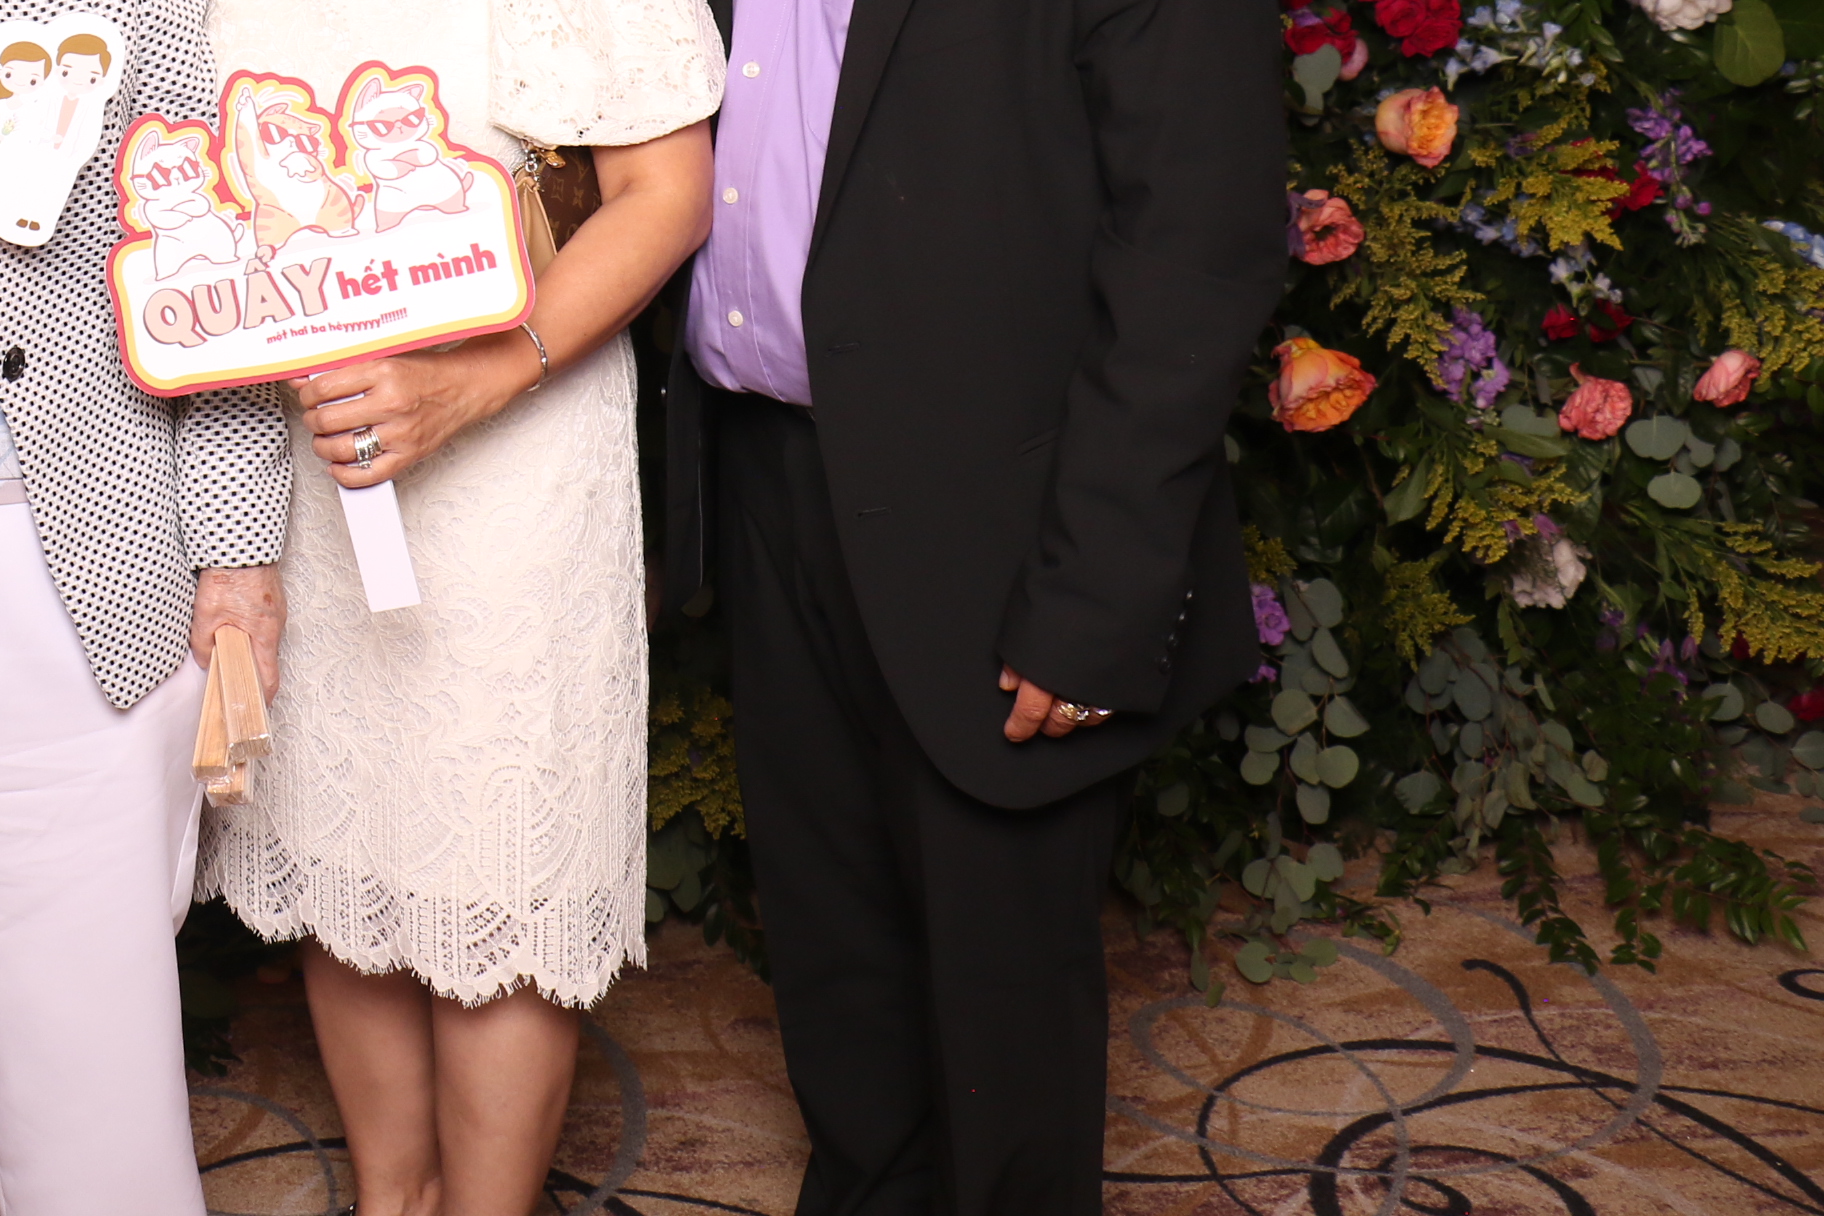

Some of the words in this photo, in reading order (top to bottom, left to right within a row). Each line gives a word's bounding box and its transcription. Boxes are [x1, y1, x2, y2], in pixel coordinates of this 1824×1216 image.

[336, 258, 398, 300] hết
[408, 242, 497, 286] mình
[290, 325, 308, 337] hai
[311, 324, 327, 334] ba
